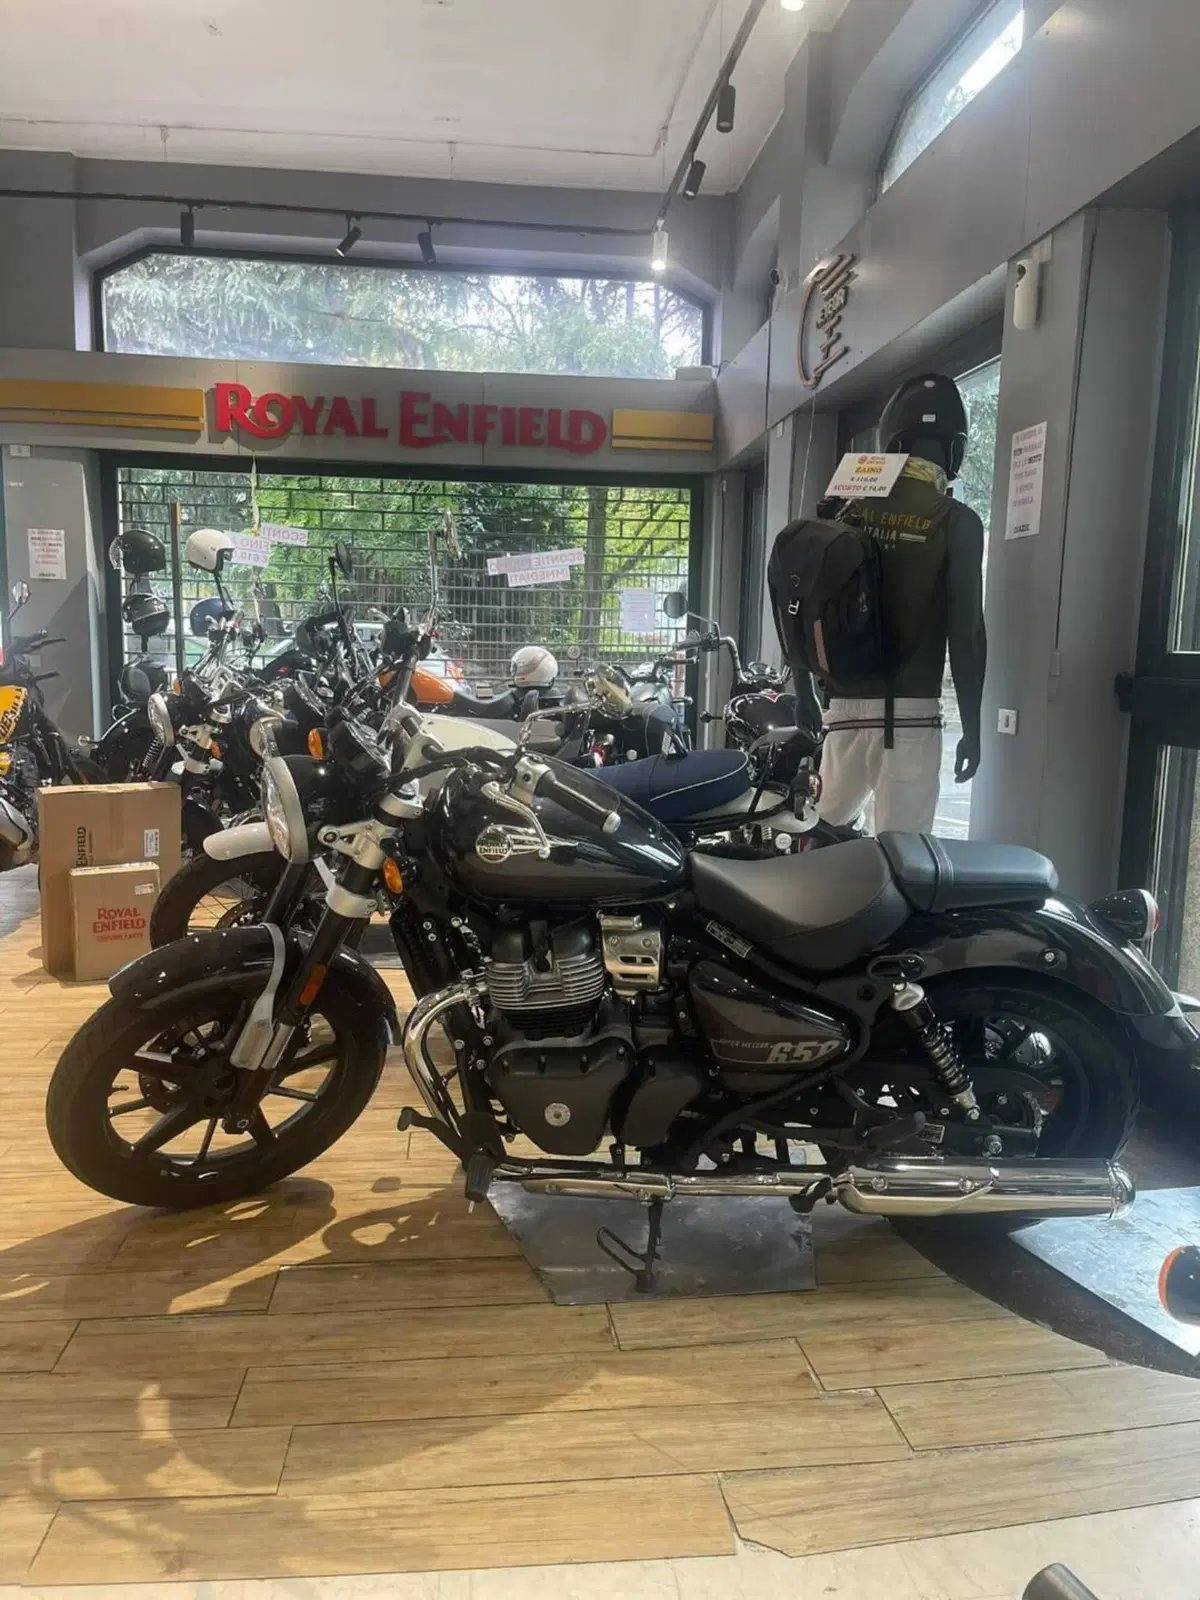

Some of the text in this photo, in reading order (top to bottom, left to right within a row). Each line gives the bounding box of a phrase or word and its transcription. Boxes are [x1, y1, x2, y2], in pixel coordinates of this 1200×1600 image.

[215, 382, 607, 454] ROYAL ENFIELD
[855, 466, 883, 474] ZAINO
[880, 511, 932, 530] ENFIELD
[76, 826, 88, 867] ENFIELD
[97, 907, 141, 920] ROYAL
[92, 918, 146, 933] ENFIELD
